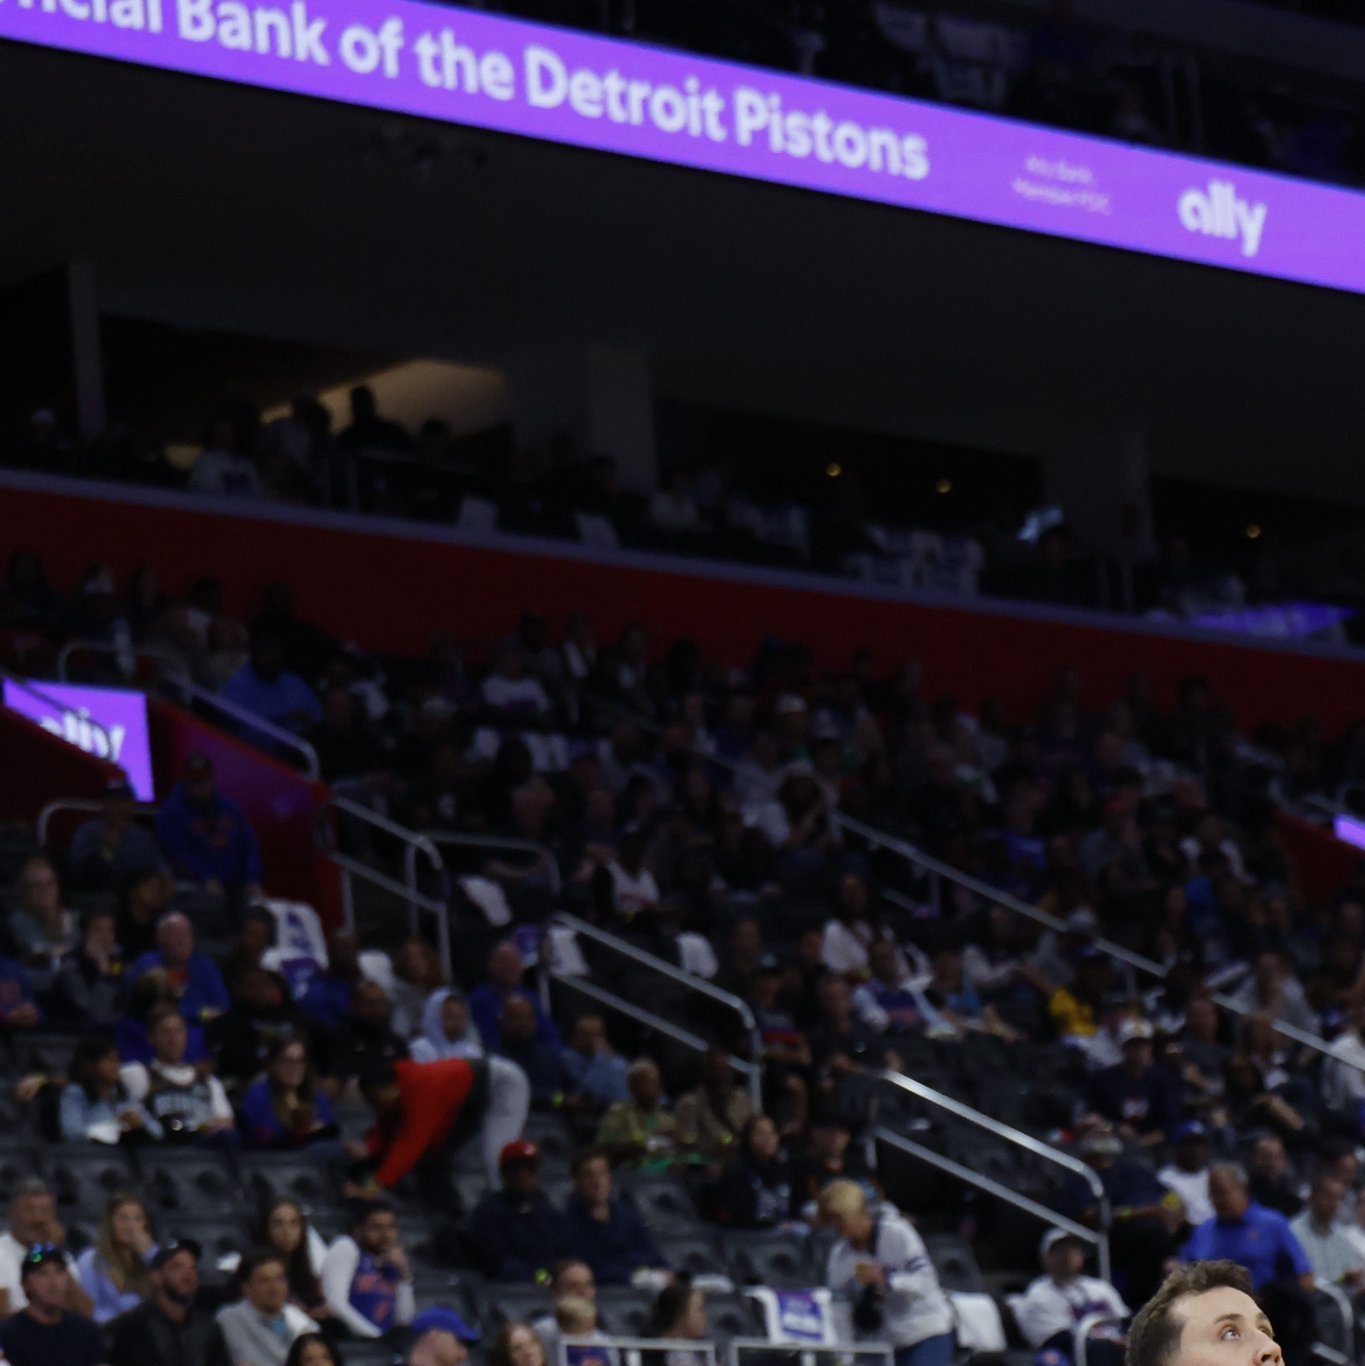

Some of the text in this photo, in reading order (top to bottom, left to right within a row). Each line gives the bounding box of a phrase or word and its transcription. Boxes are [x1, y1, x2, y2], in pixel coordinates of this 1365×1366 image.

[177, 0, 331, 65] Bank
[339, 16, 402, 79] of
[415, 29, 515, 101] the
[523, 45, 728, 142] Detroit
[733, 86, 930, 180] Pistons
[1178, 179, 1268, 259] ally
